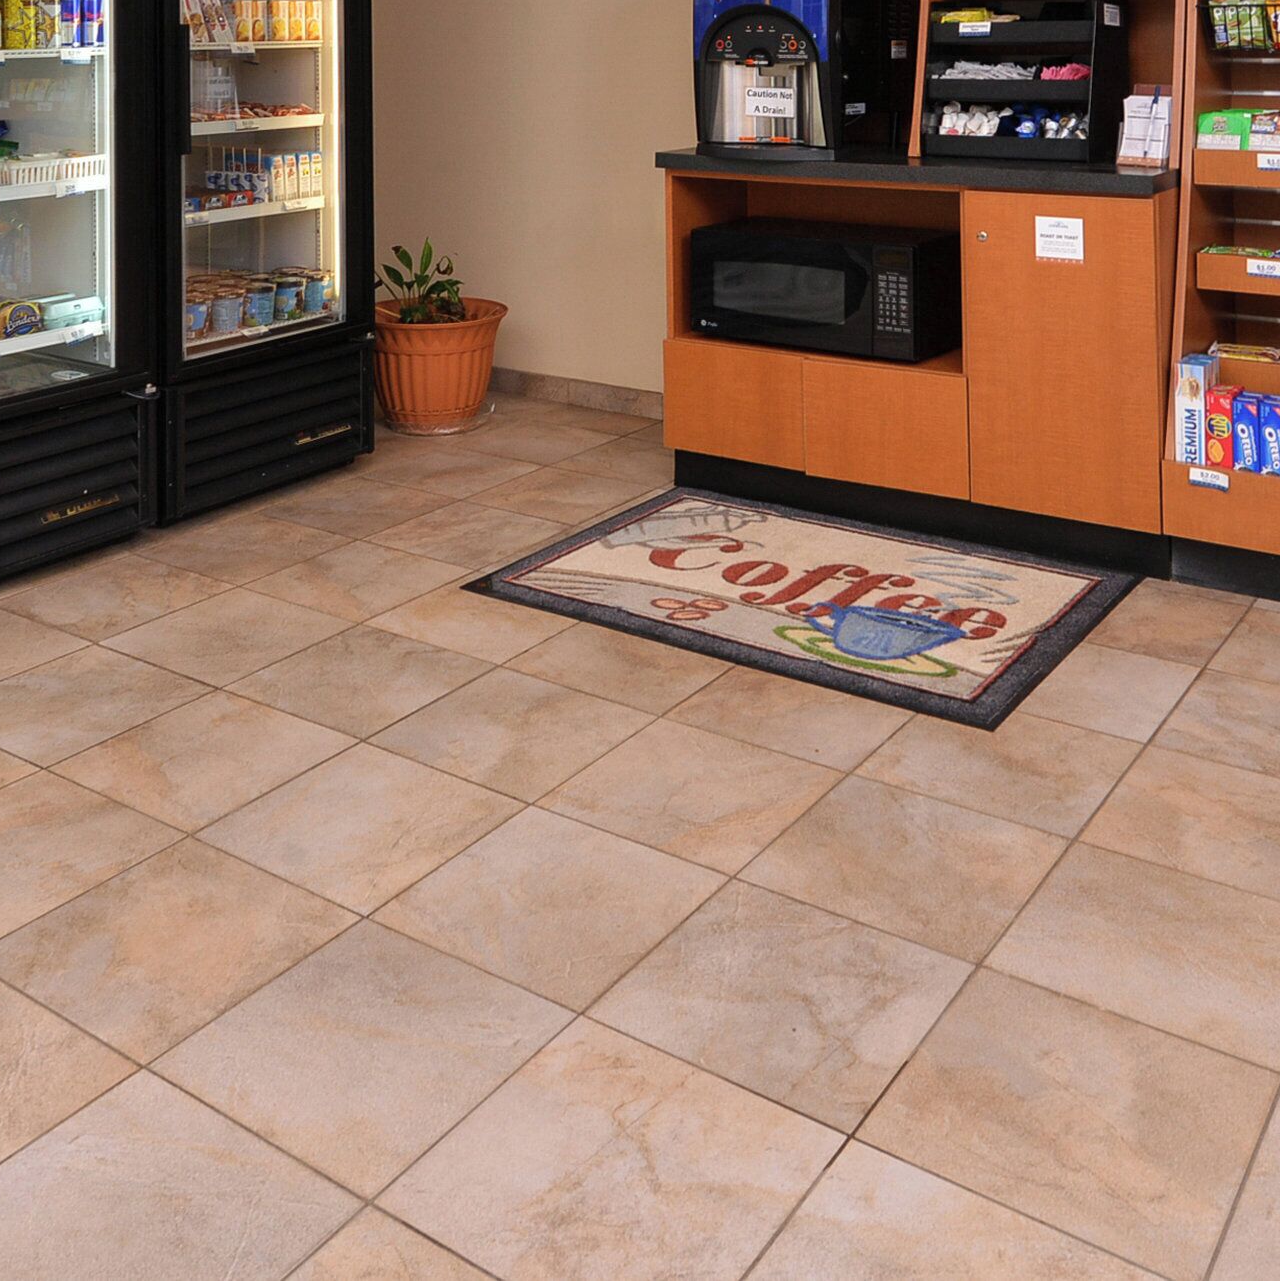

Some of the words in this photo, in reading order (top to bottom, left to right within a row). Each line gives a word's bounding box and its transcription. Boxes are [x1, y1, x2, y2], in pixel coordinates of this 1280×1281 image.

[746, 89, 778, 99] Caution
[779, 91, 793, 100] Not
[754, 105, 761, 114] A
[762, 104, 786, 115] Drain!
[1185, 408, 1198, 465] REMIUM
[1235, 423, 1253, 466] OREO
[1263, 426, 1280, 470] OREO
[648, 534, 1008, 640] Coffee
